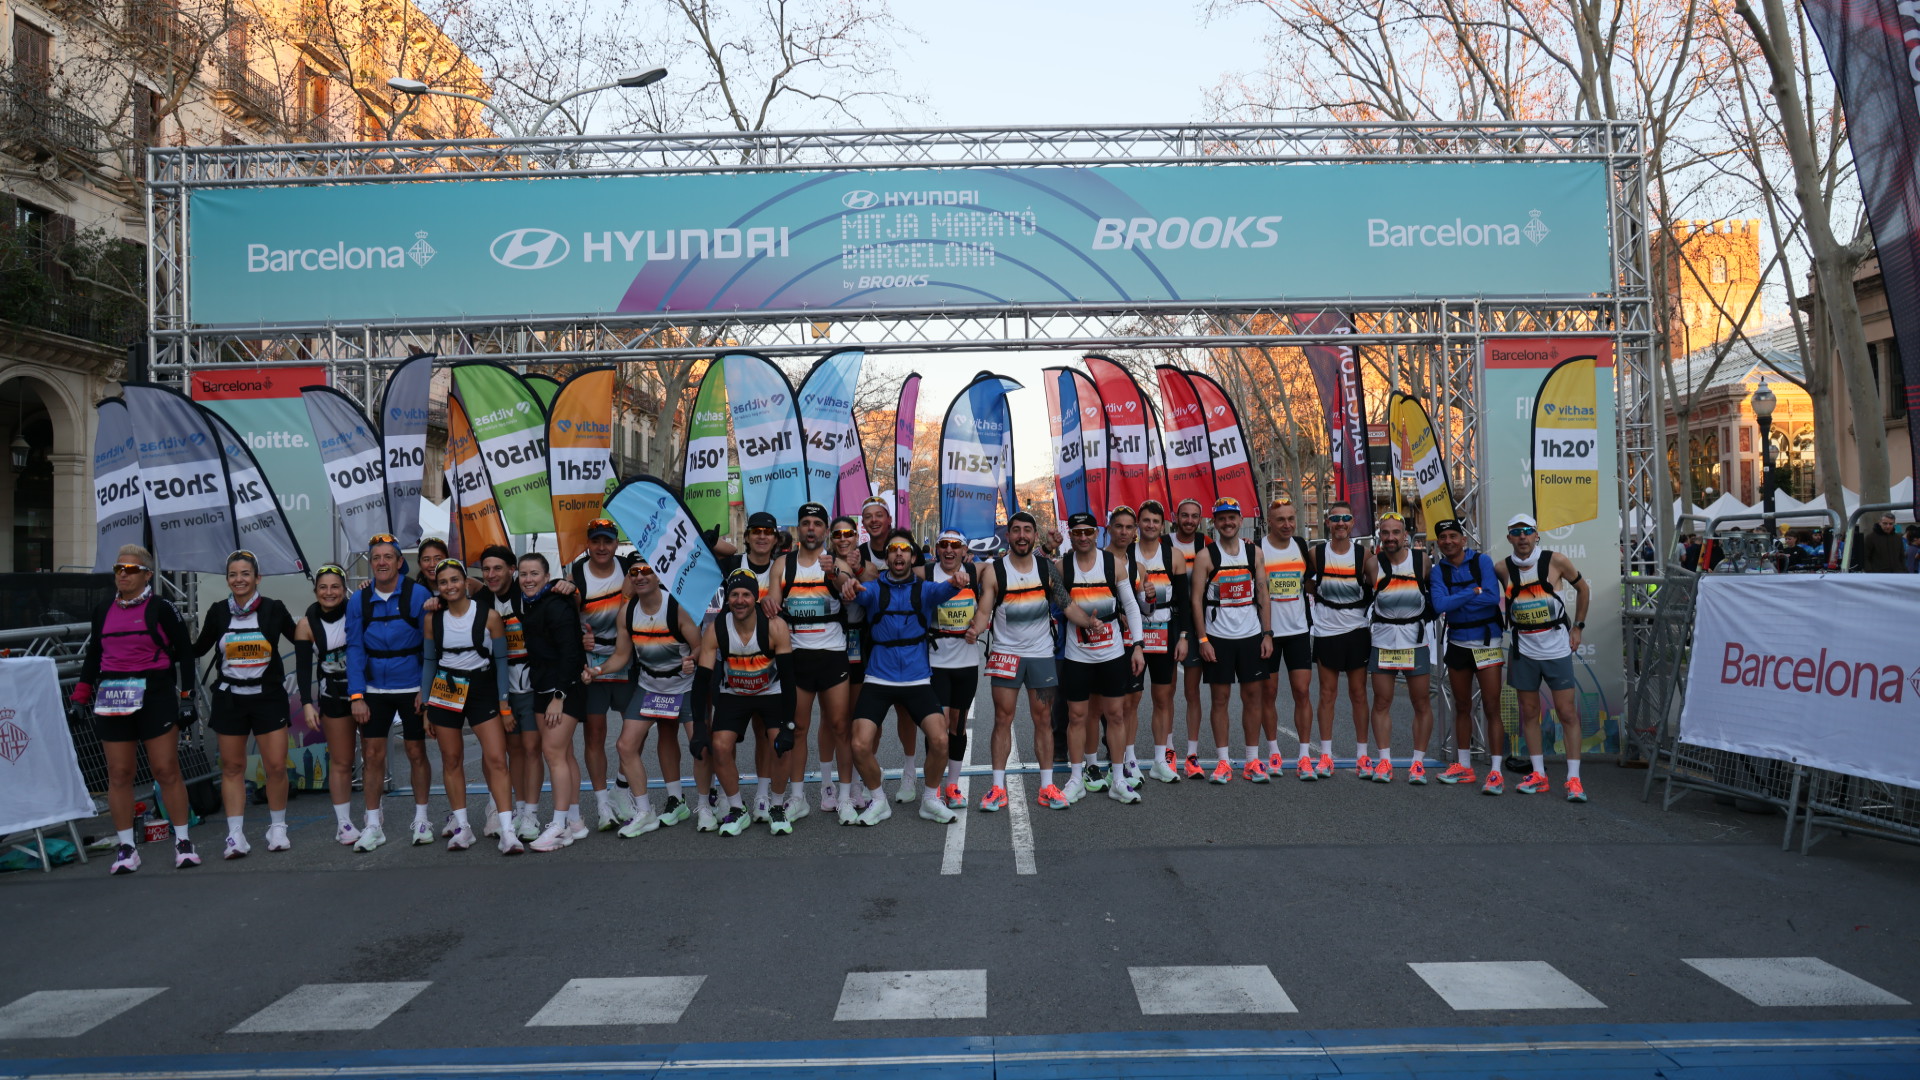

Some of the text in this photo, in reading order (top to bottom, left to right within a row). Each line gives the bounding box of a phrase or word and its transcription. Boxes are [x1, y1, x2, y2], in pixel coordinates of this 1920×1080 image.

[884, 190, 979, 206] HYUNDAI
[841, 205, 1037, 239] MITJA MARATÓ
[1091, 215, 1283, 250] BROOKS
[1367, 217, 1520, 247] Barcelona
[584, 227, 789, 262] HYUNDAI
[247, 241, 405, 272] Barcelona
[842, 241, 995, 270] BARCELONA
[843, 274, 930, 290] by BROOKS
[1491, 349, 1548, 361] Barcelona
[202, 380, 262, 393] Barcelona
[404, 409, 429, 420] vitha
[1558, 405, 1594, 415] vithas
[575, 420, 610, 433] vithas
[969, 418, 1003, 431] vithas
[241, 431, 310, 448] loitte.
[1541, 439, 1595, 458] 1h20'
[388, 446, 425, 469] 2h0
[948, 451, 998, 474] 1h35'
[558, 460, 606, 481] 1h55'
[815, 468, 831, 479] me
[1540, 474, 1592, 484] Follow me
[706, 487, 721, 498] me
[976, 492, 993, 501] me
[558, 499, 600, 511] Follow me
[1274, 580, 1297, 588] SERGIO
[794, 609, 816, 617] DAVID
[947, 610, 967, 619] RAFA
[1531, 609, 1549, 619] LUIS
[237, 644, 261, 653] ROMI
[1720, 641, 1904, 704] Barcelona
[433, 681, 453, 693] KARE
[732, 677, 765, 685] MANUEL
[105, 690, 136, 699] MAYTE
[651, 695, 676, 704] JESUS
